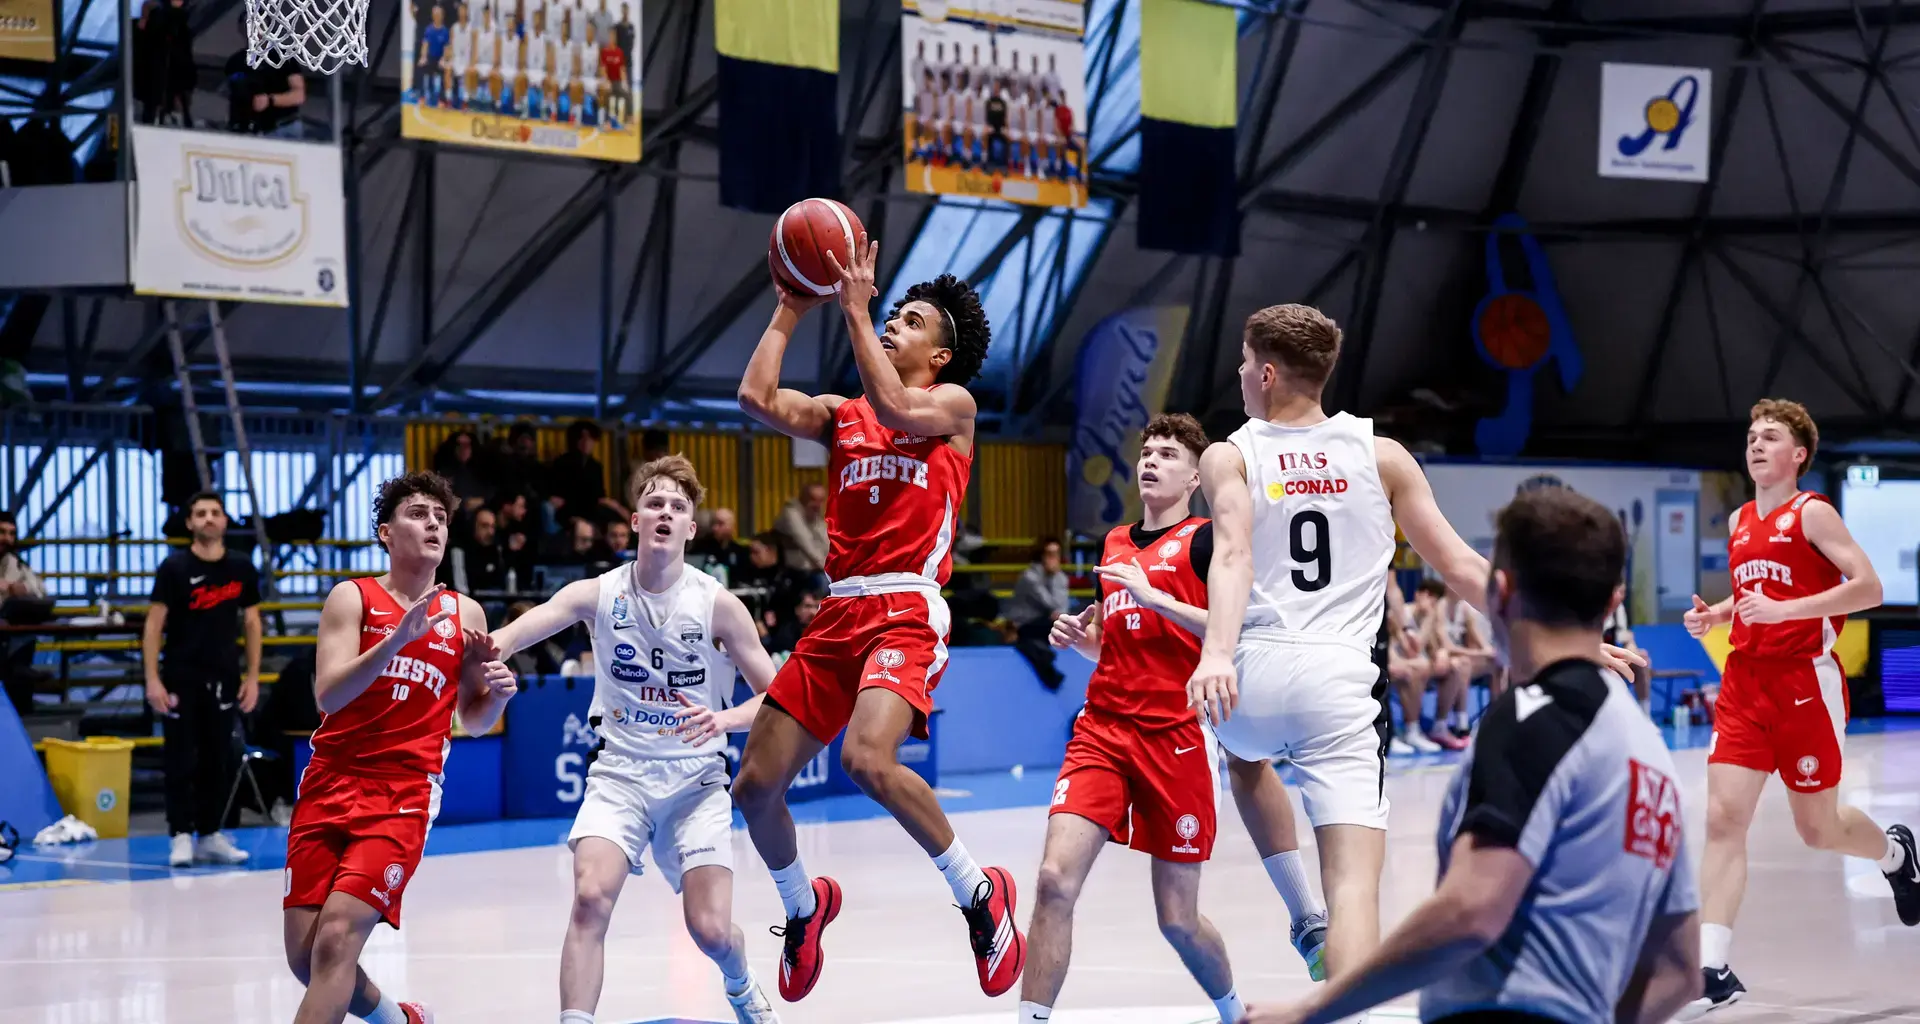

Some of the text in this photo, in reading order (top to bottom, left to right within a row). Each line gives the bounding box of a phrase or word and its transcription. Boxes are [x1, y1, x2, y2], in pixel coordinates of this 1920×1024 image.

[195, 158, 288, 210] Dulca
[1277, 452, 1328, 471] ITAS
[839, 455, 928, 494] TRIESTE
[869, 485, 880, 504] 3
[1285, 479, 1348, 495] CONAD
[1289, 510, 1331, 592] 9
[1733, 559, 1793, 588] TRIESTE
[1125, 613, 1141, 630] 12
[651, 648, 664, 670] 6
[612, 665, 648, 678] Melinda
[392, 683, 410, 701] 10
[640, 686, 679, 702] ITAS
[634, 710, 691, 726] Dolom
